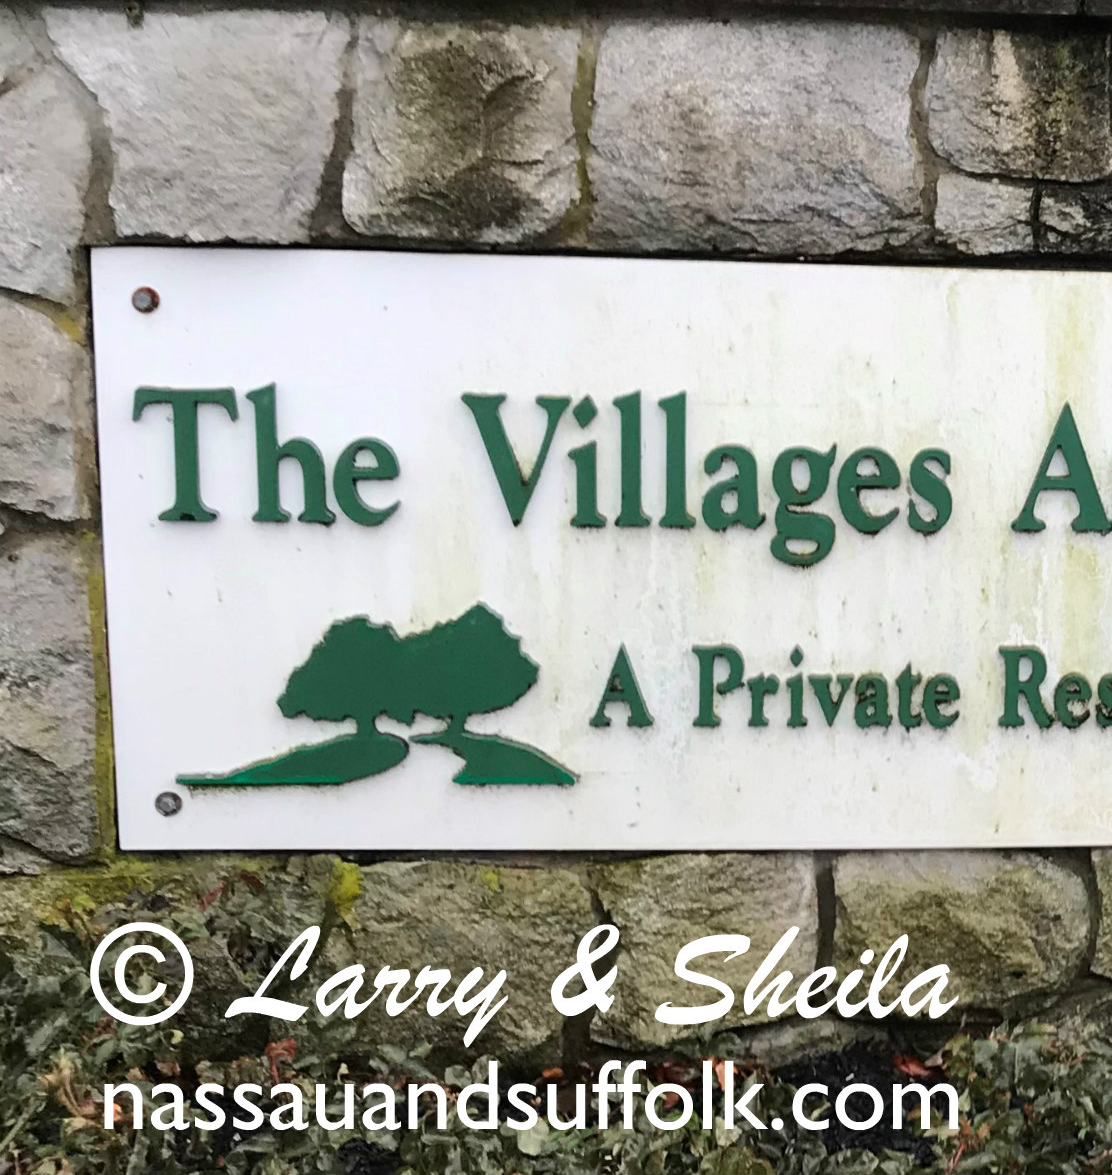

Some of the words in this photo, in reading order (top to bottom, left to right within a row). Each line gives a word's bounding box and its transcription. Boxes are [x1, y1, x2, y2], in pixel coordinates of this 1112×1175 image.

[132, 382, 401, 527] The
[460, 390, 954, 567] Villages
[590, 643, 653, 728] A
[692, 646, 961, 730] Private
